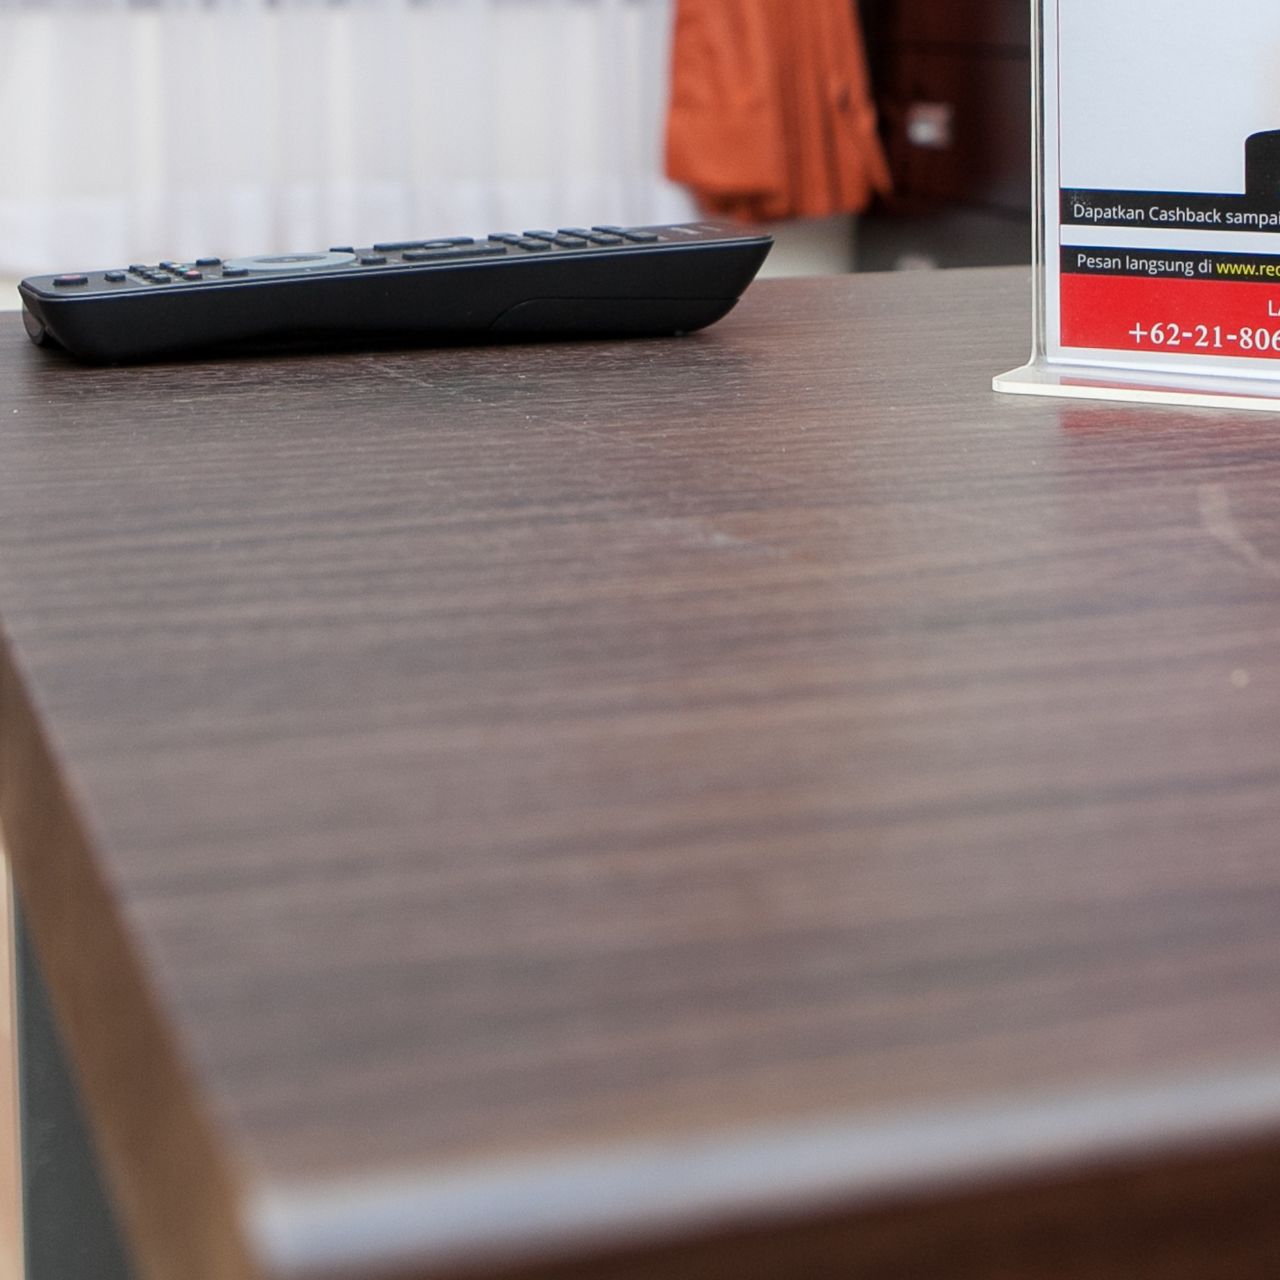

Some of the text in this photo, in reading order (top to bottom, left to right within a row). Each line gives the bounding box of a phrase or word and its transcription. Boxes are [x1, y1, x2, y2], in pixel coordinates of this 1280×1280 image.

[1073, 203, 1145, 222] Dapatkan
[1148, 206, 1222, 224] Cashback
[1076, 253, 1121, 270] Pesan
[1125, 255, 1194, 277] langsung
[1198, 258, 1213, 274] di
